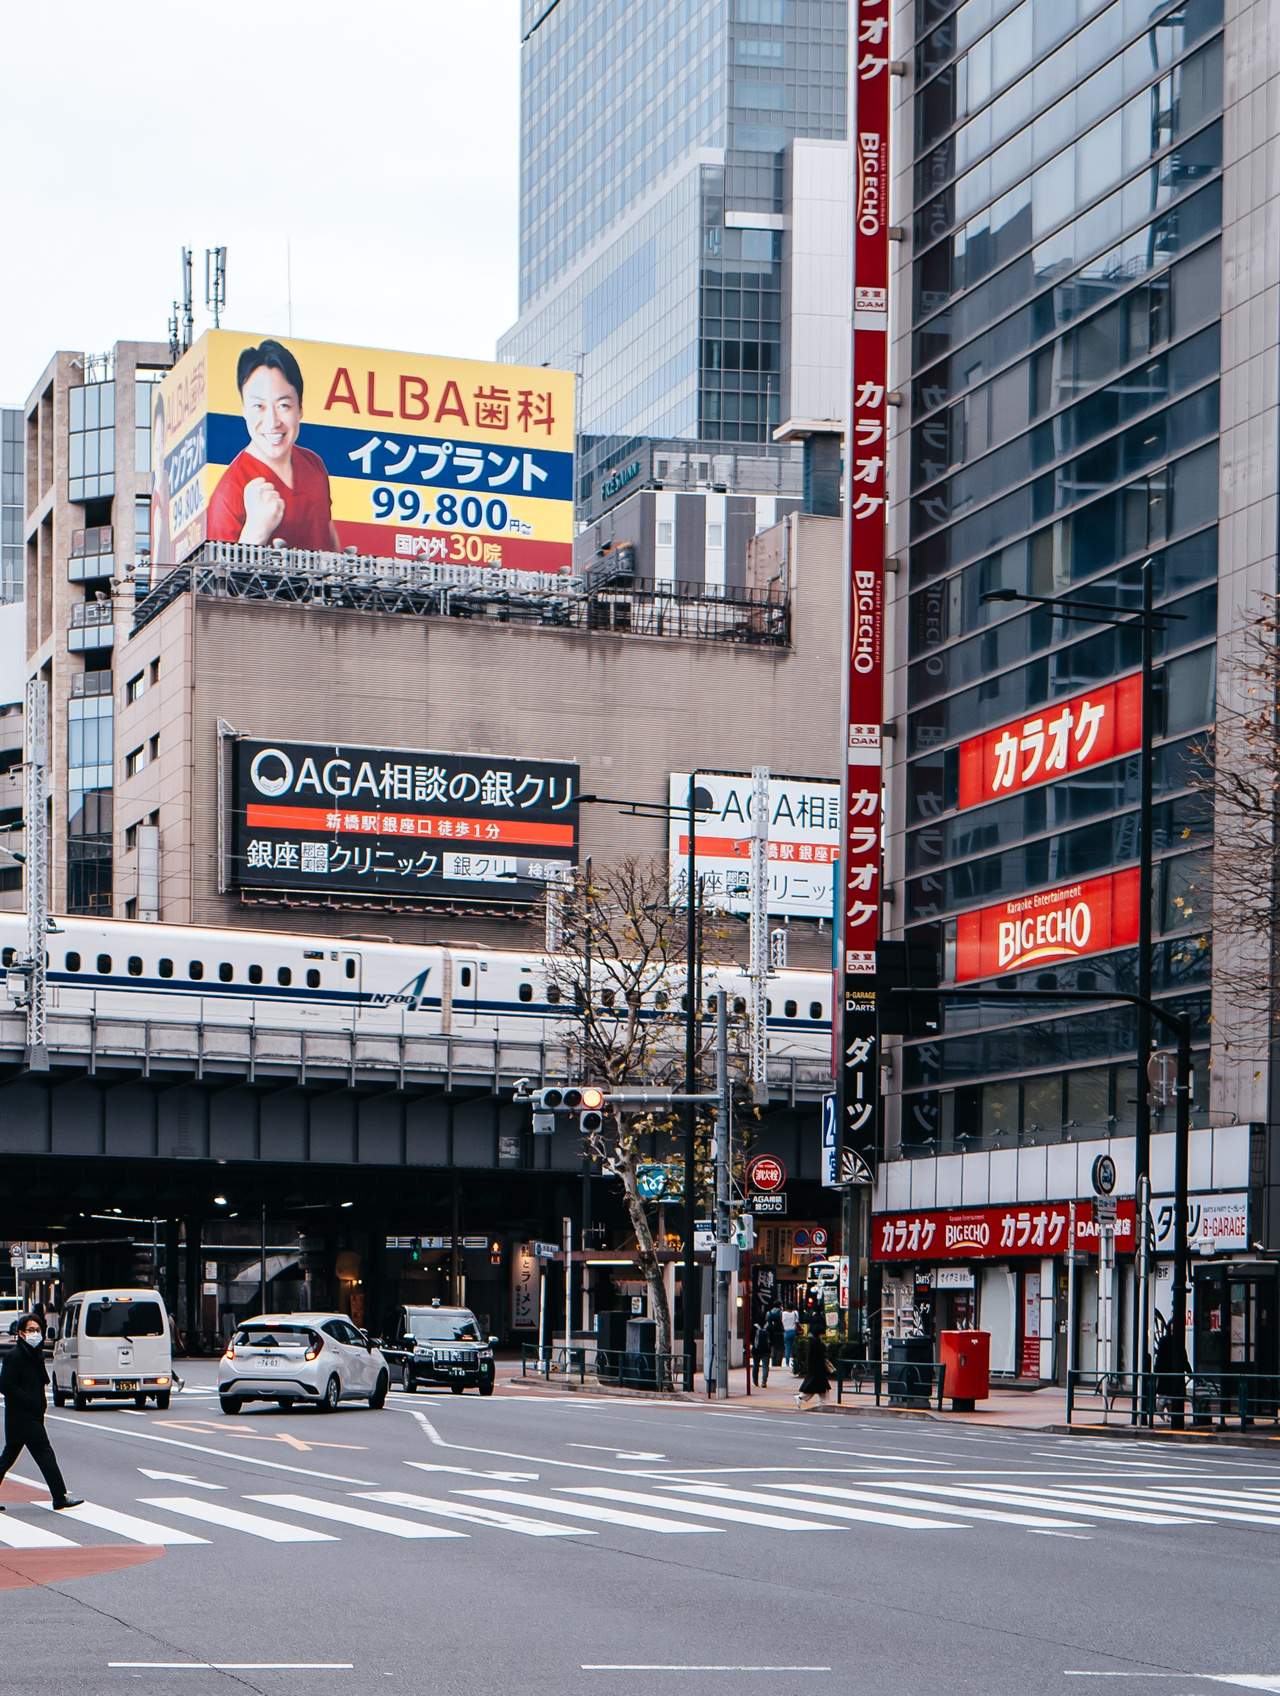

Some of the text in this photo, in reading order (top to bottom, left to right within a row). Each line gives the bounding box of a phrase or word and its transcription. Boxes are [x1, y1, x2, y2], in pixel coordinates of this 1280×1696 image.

[858, 0, 888, 80] オケ
[856, 301, 885, 310] DAM
[348, 435, 550, 492] インプラント
[852, 380, 885, 520] カラオケ
[851, 736, 879, 746] DAM
[992, 700, 1106, 792] カラオケ
[295, 757, 573, 811] AGA相談の銀クリ
[847, 788, 879, 928] カラオケ
[1007, 885, 1082, 915] Karaoke Entertainment
[847, 963, 876, 972] DAM
[845, 1035, 876, 1131] ダーツ
[881, 1218, 936, 1253] カラオケ
[1000, 1211, 1066, 1248] カラオケ
[1203, 1216, 1246, 1237] B-GARAGE
